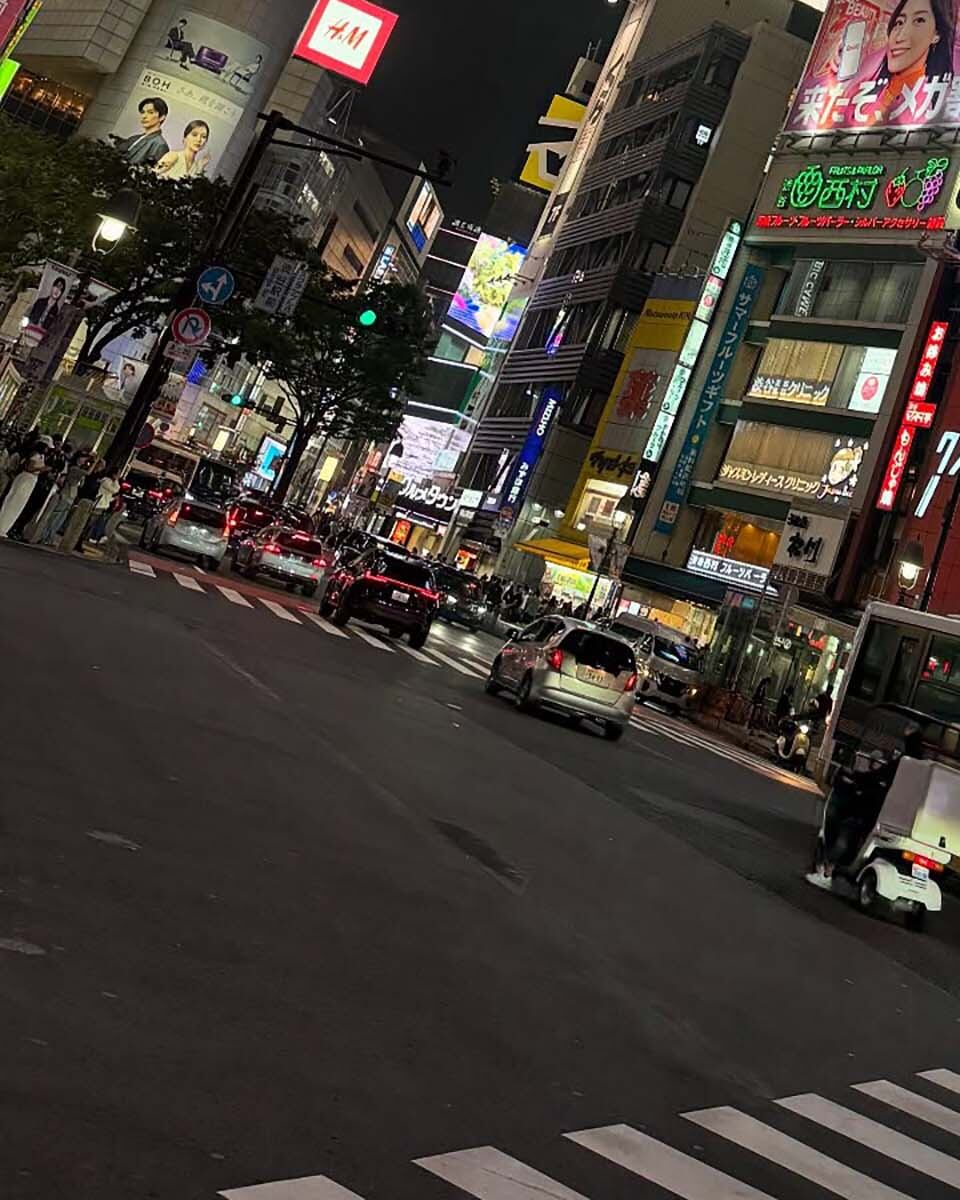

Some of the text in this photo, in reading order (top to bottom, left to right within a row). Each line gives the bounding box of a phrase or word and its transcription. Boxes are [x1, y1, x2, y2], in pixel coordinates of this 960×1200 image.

[327, 18, 369, 51] H&M
[695, 292, 752, 429] サマーフルーツギフト
[537, 398, 557, 436] MIZUHO
